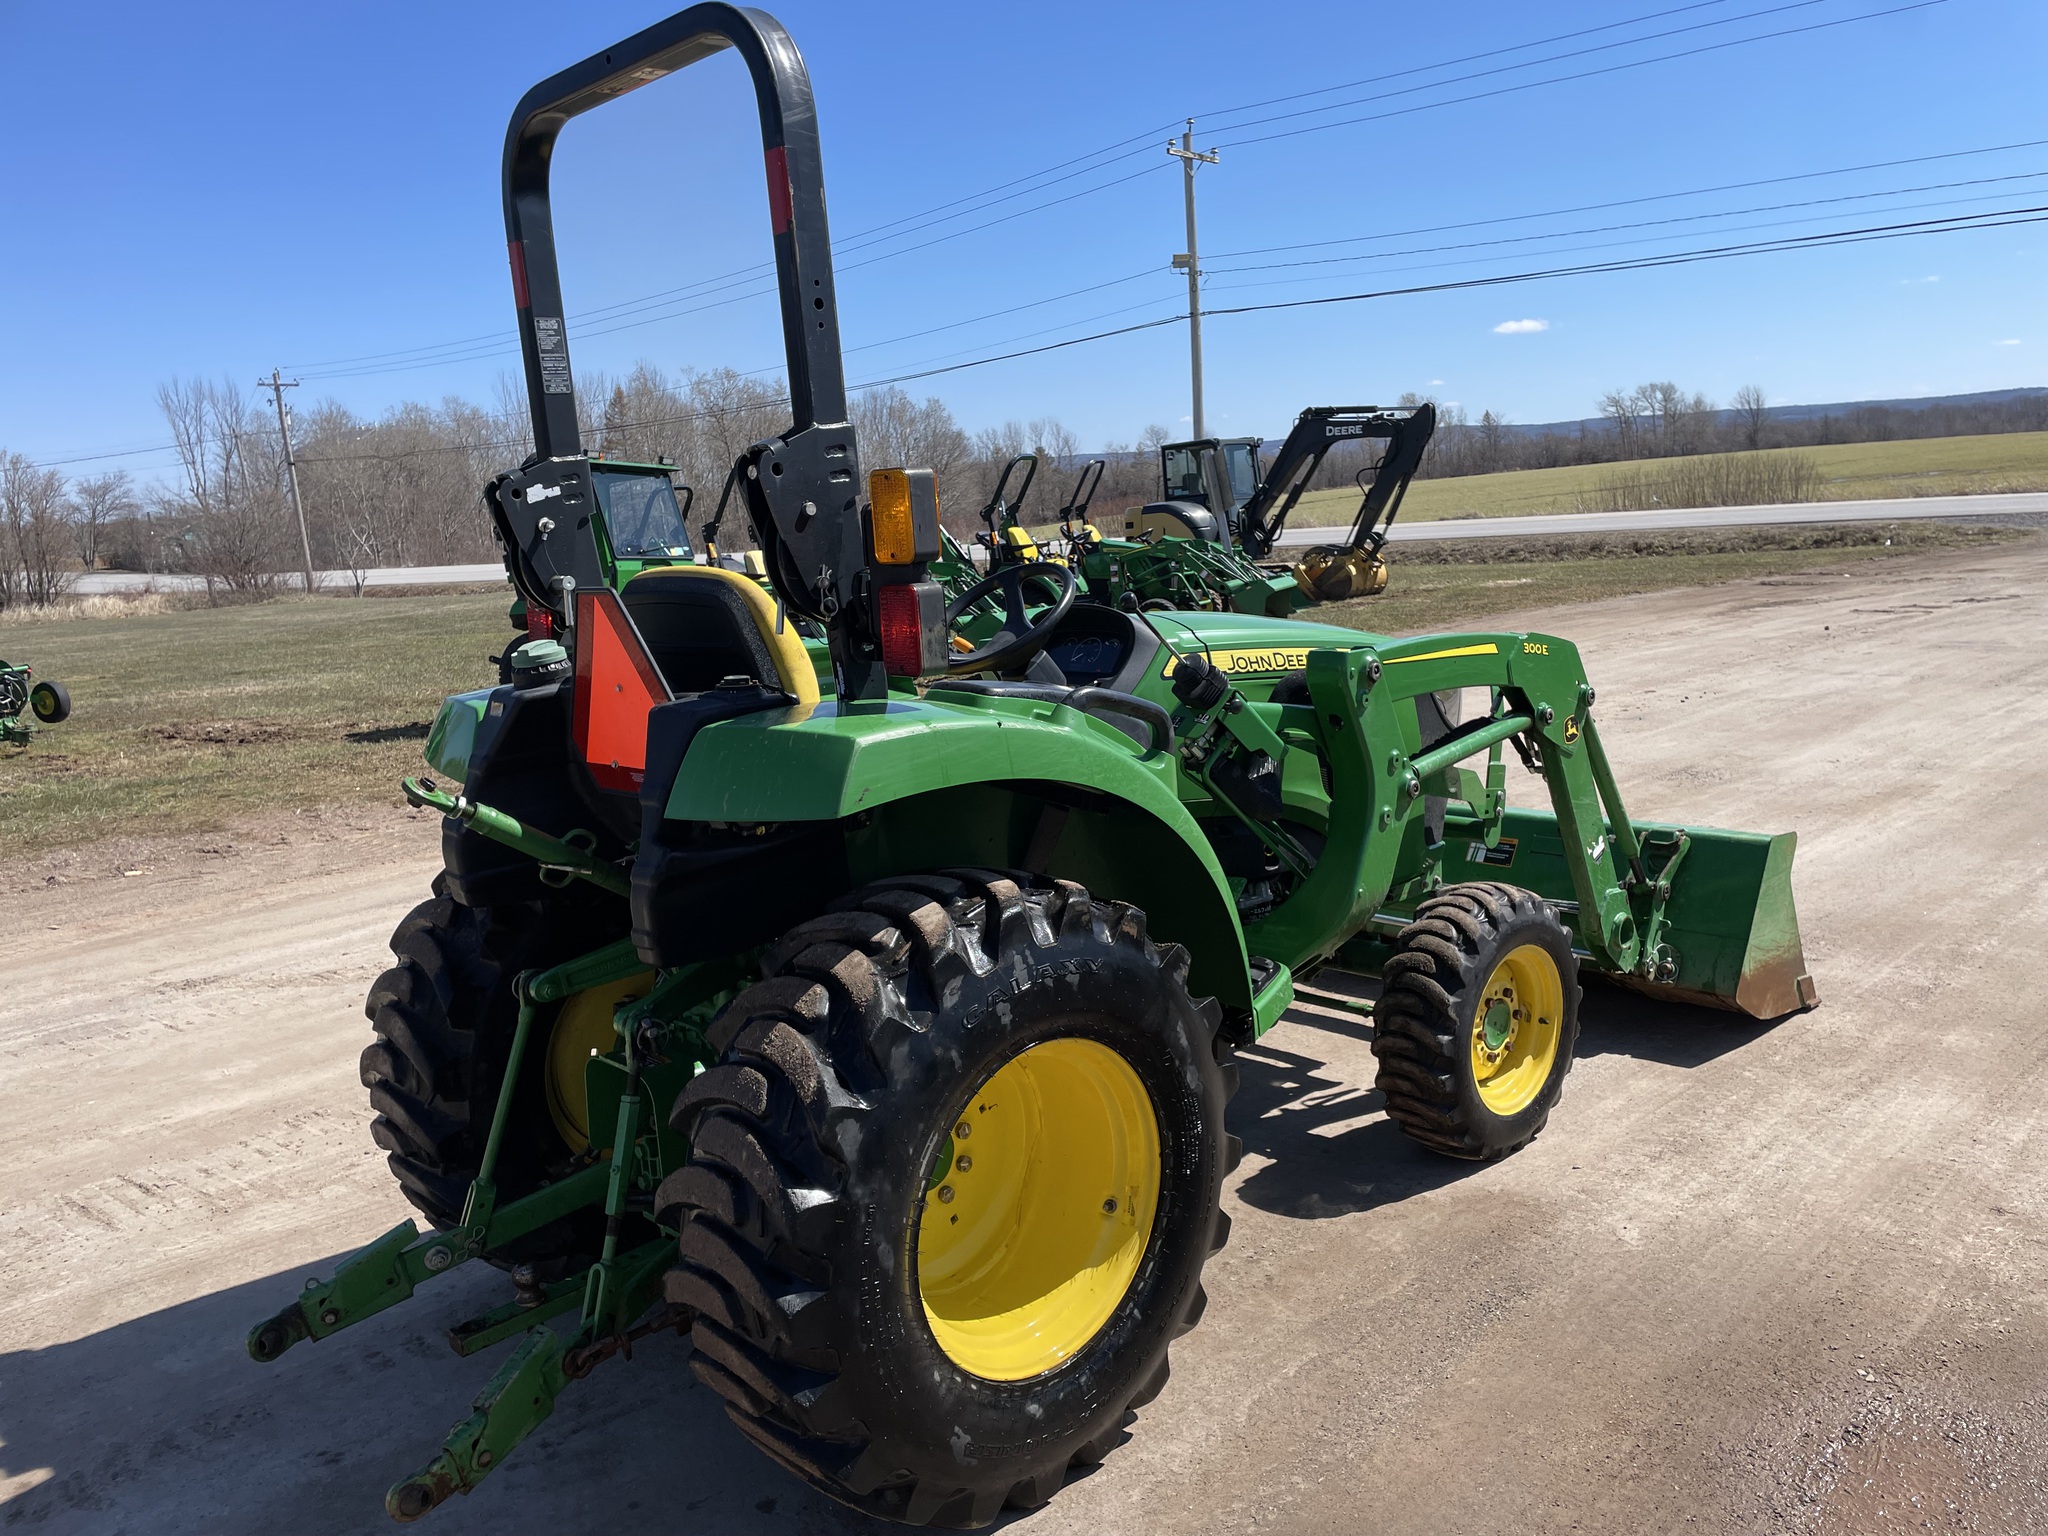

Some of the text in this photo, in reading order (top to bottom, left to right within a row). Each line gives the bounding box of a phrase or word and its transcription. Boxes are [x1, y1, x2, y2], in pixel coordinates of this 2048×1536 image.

[1325, 425, 1363, 437] DEERE
[1227, 652, 1309, 671] JOHN DEE
[962, 957, 1105, 1029] GALAXY
